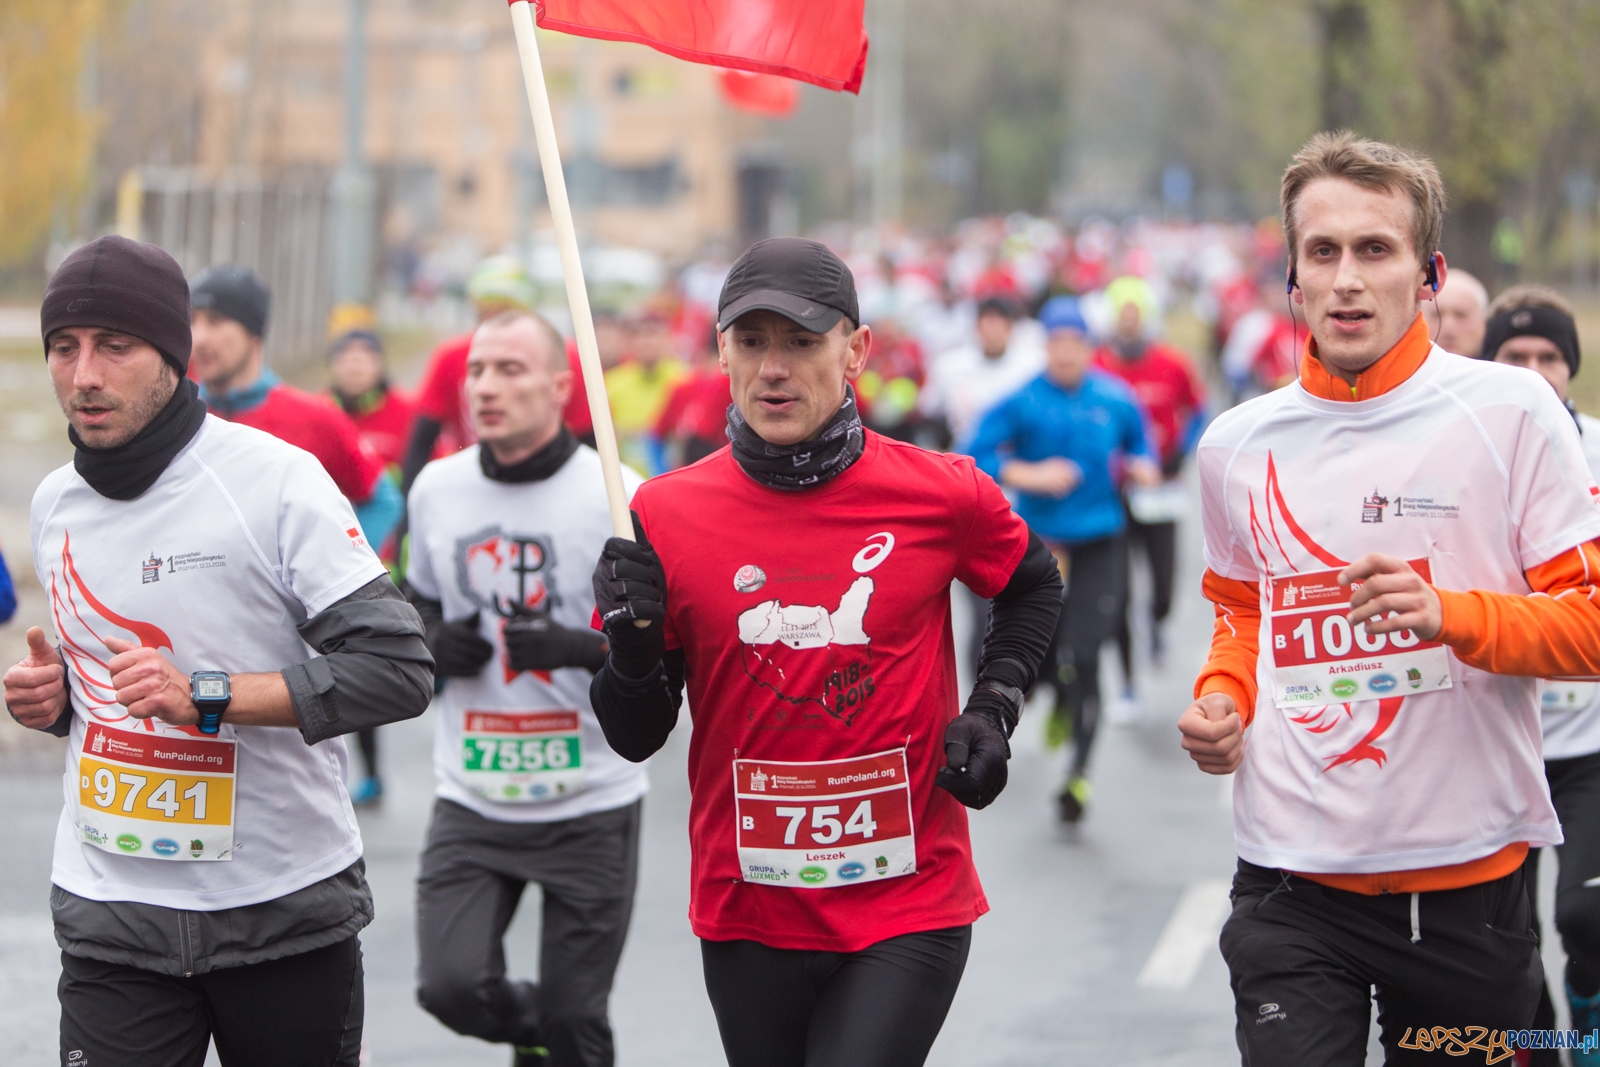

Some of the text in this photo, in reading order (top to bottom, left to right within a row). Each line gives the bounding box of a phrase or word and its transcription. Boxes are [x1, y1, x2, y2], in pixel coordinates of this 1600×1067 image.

[174, 551, 201, 560] Poznański
[781, 624, 818, 632] 11.11.2015
[777, 631, 821, 641] WARSZAWA
[1274, 634, 1287, 649] B
[1328, 661, 1384, 675] Arkadiusz
[835, 676, 876, 714] 2015
[1285, 685, 1309, 694] GRUPA
[1285, 692, 1314, 702] LUXMED
[153, 749, 223, 765] RunPoland.org
[475, 738, 571, 771] 7556
[827, 767, 896, 786] RunPoland.org
[81, 767, 208, 821] D 9741
[742, 799, 877, 845] B 754
[84, 824, 99, 836] GRUPA
[805, 851, 846, 862] Leszek
[749, 865, 775, 873] GRUPA
[750, 872, 781, 881] LUXMED
